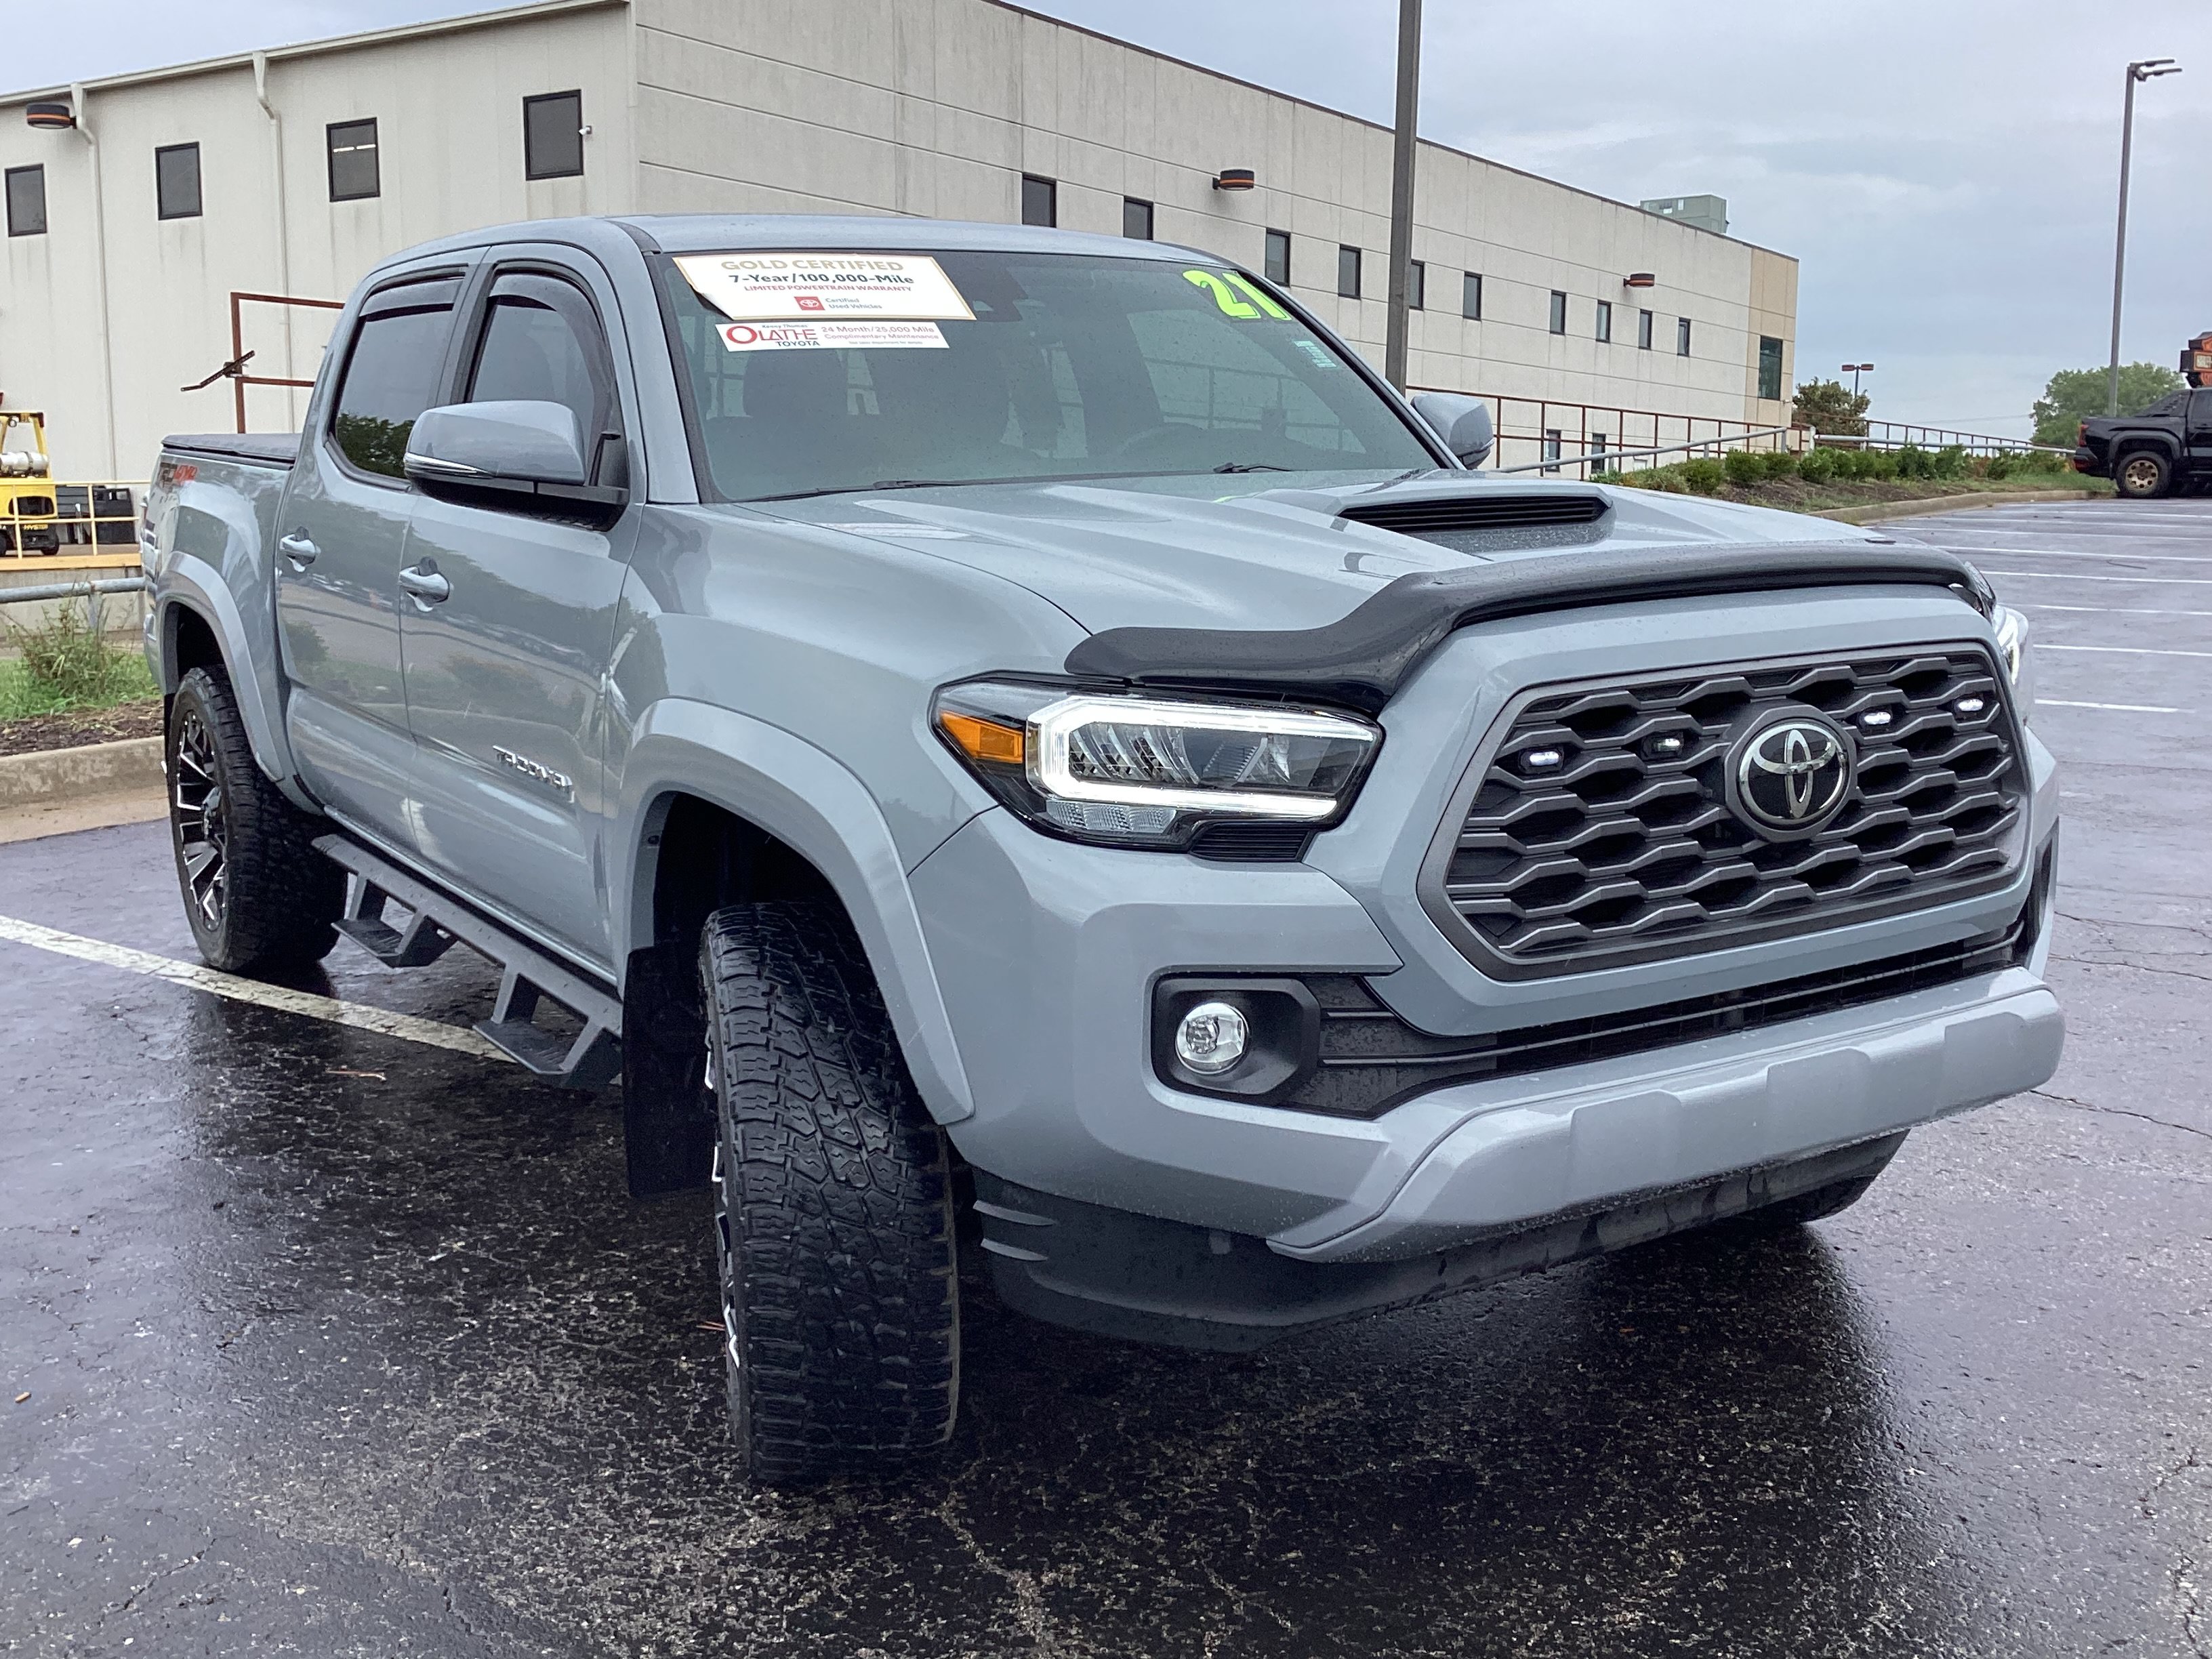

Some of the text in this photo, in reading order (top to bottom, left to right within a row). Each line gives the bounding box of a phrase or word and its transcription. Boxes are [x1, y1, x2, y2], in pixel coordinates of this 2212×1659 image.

[721, 260, 904, 271] GOLD CERTIFIED
[1182, 270, 1292, 321] 21
[726, 325, 819, 344] OLATHE
